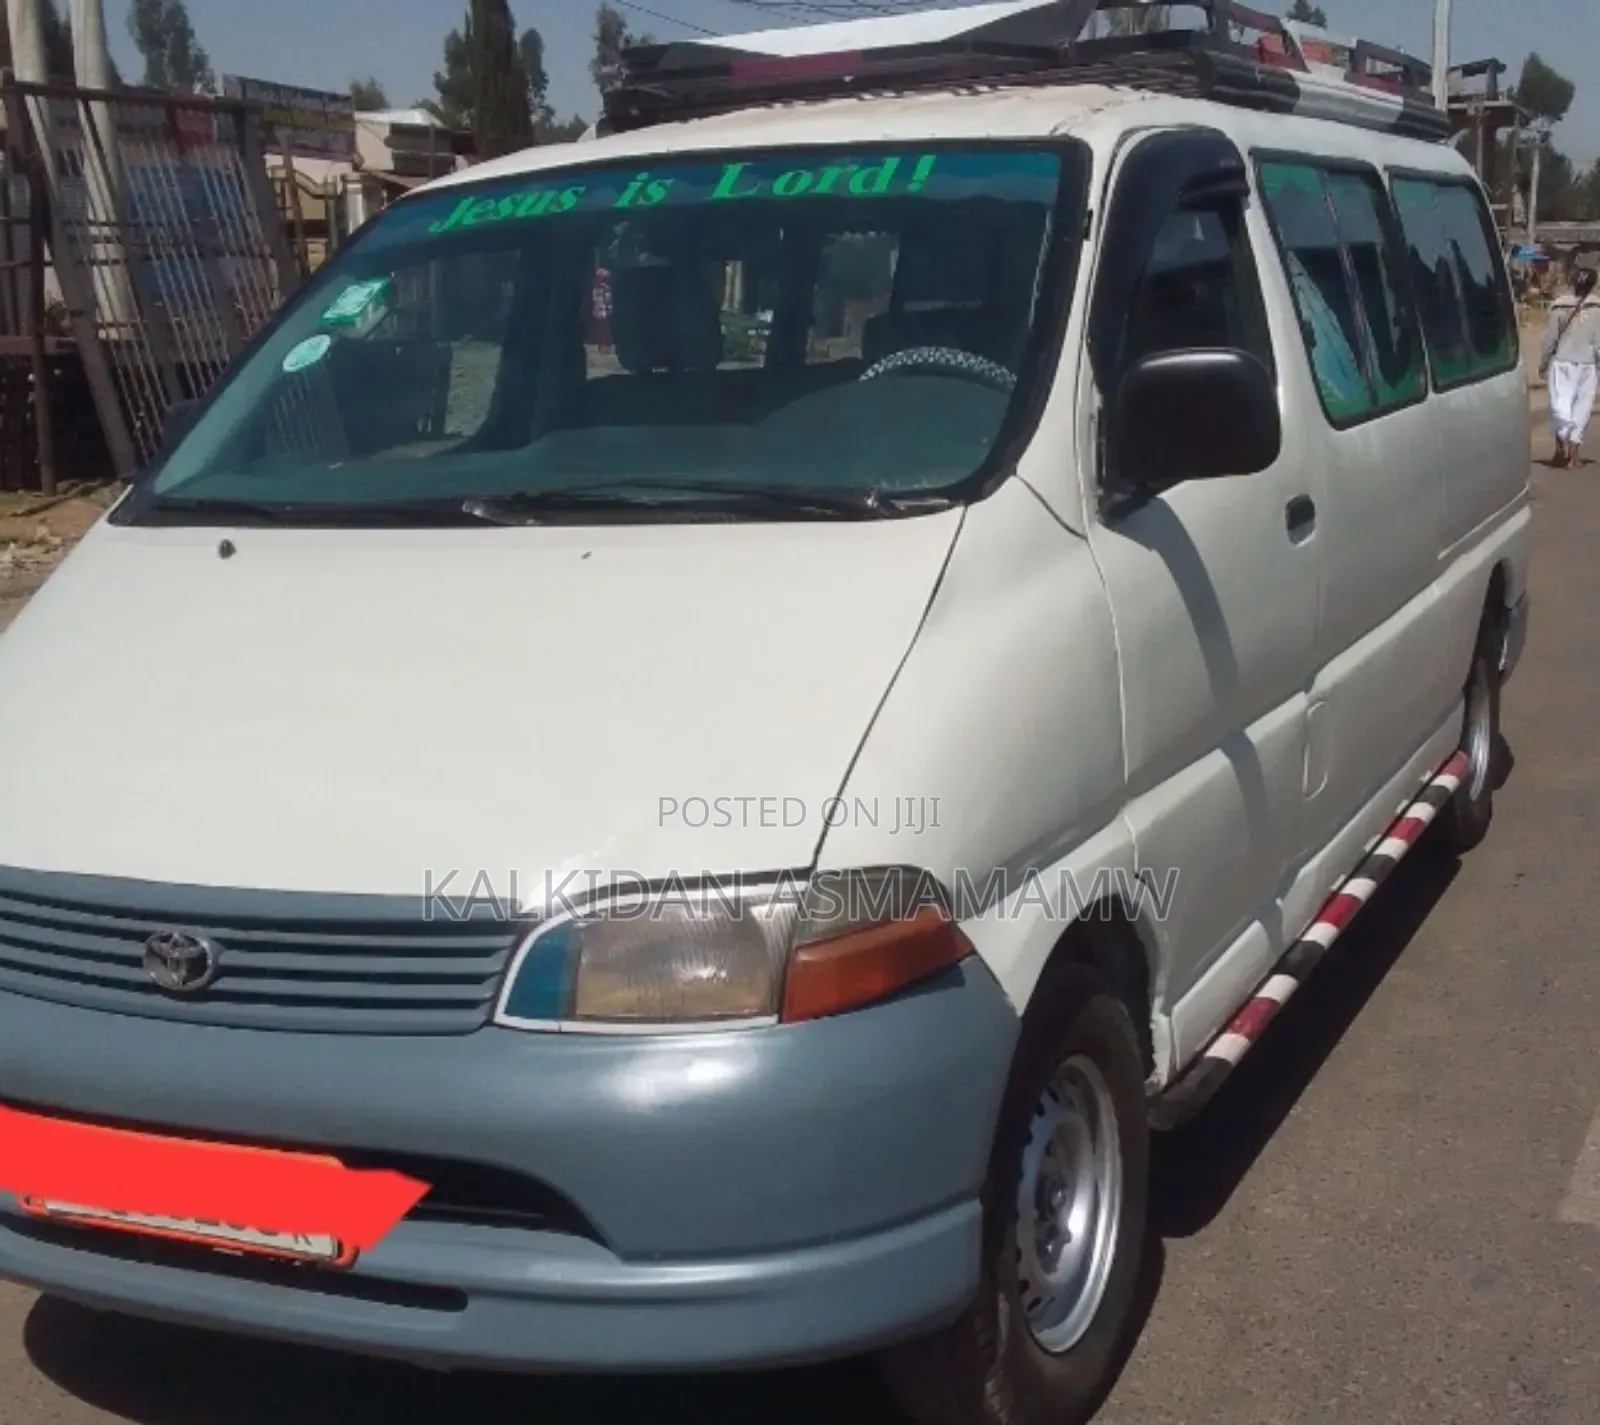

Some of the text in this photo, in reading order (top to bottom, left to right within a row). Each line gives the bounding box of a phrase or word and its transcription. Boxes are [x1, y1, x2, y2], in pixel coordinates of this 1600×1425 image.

[429, 154, 937, 233] Jesus is Lord!
